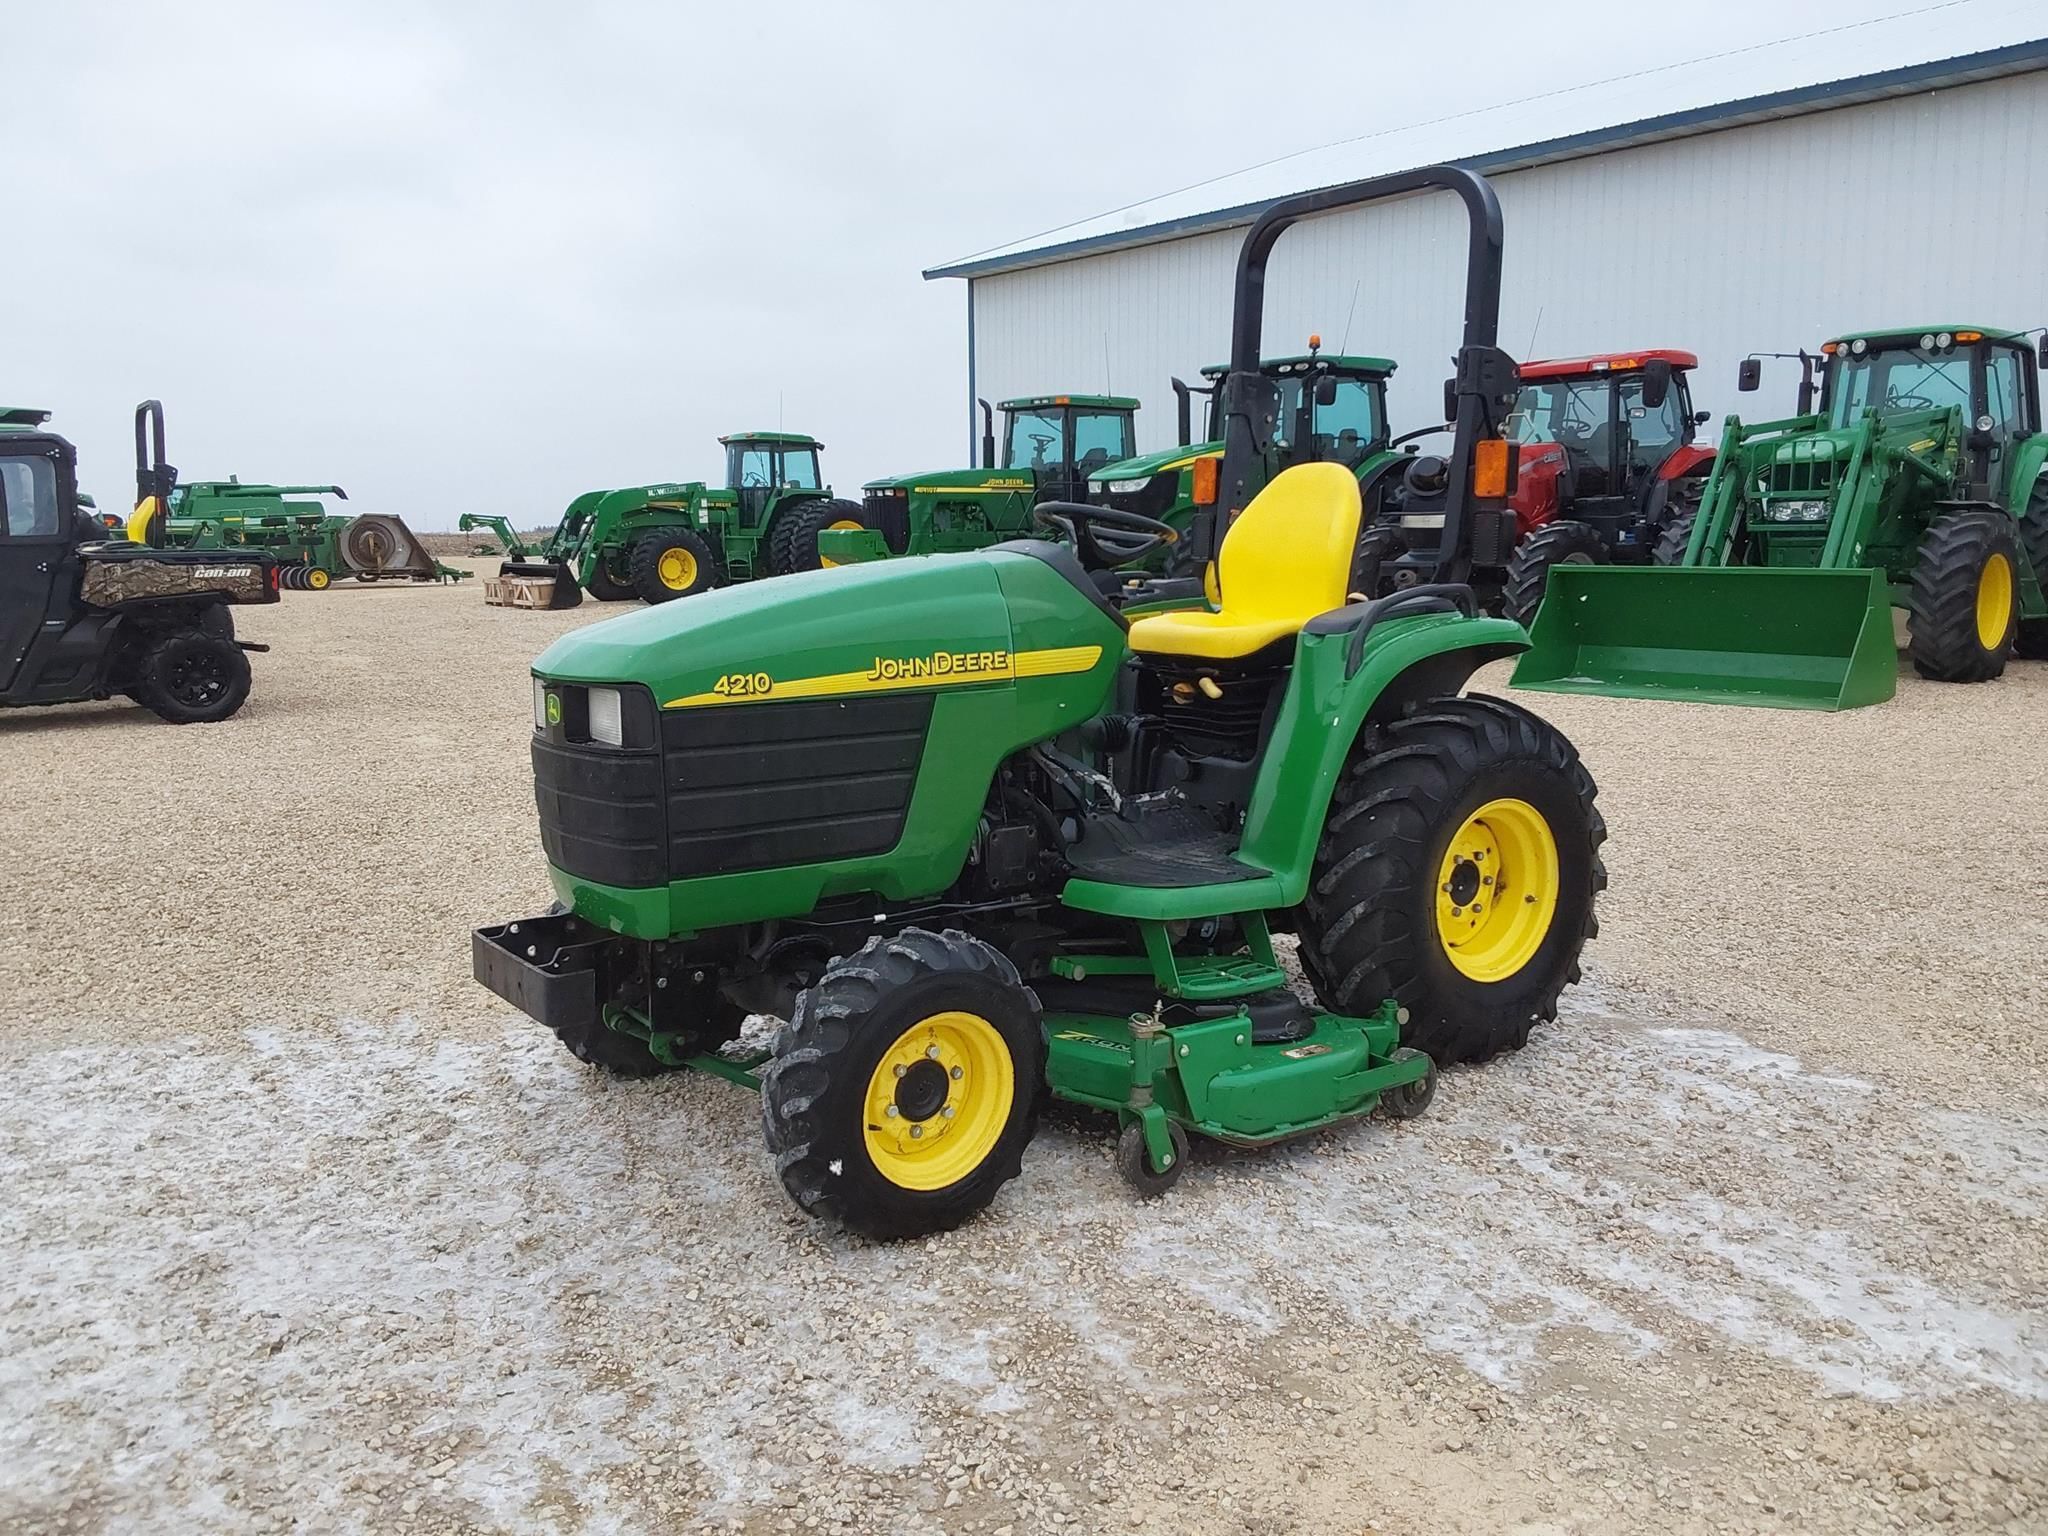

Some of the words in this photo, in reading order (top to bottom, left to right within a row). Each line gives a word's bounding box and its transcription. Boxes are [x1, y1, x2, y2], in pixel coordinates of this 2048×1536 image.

[194, 568, 251, 578] can-am
[866, 656, 933, 681] JOHN
[933, 651, 1008, 674] DEERE
[713, 672, 774, 695] 4210
